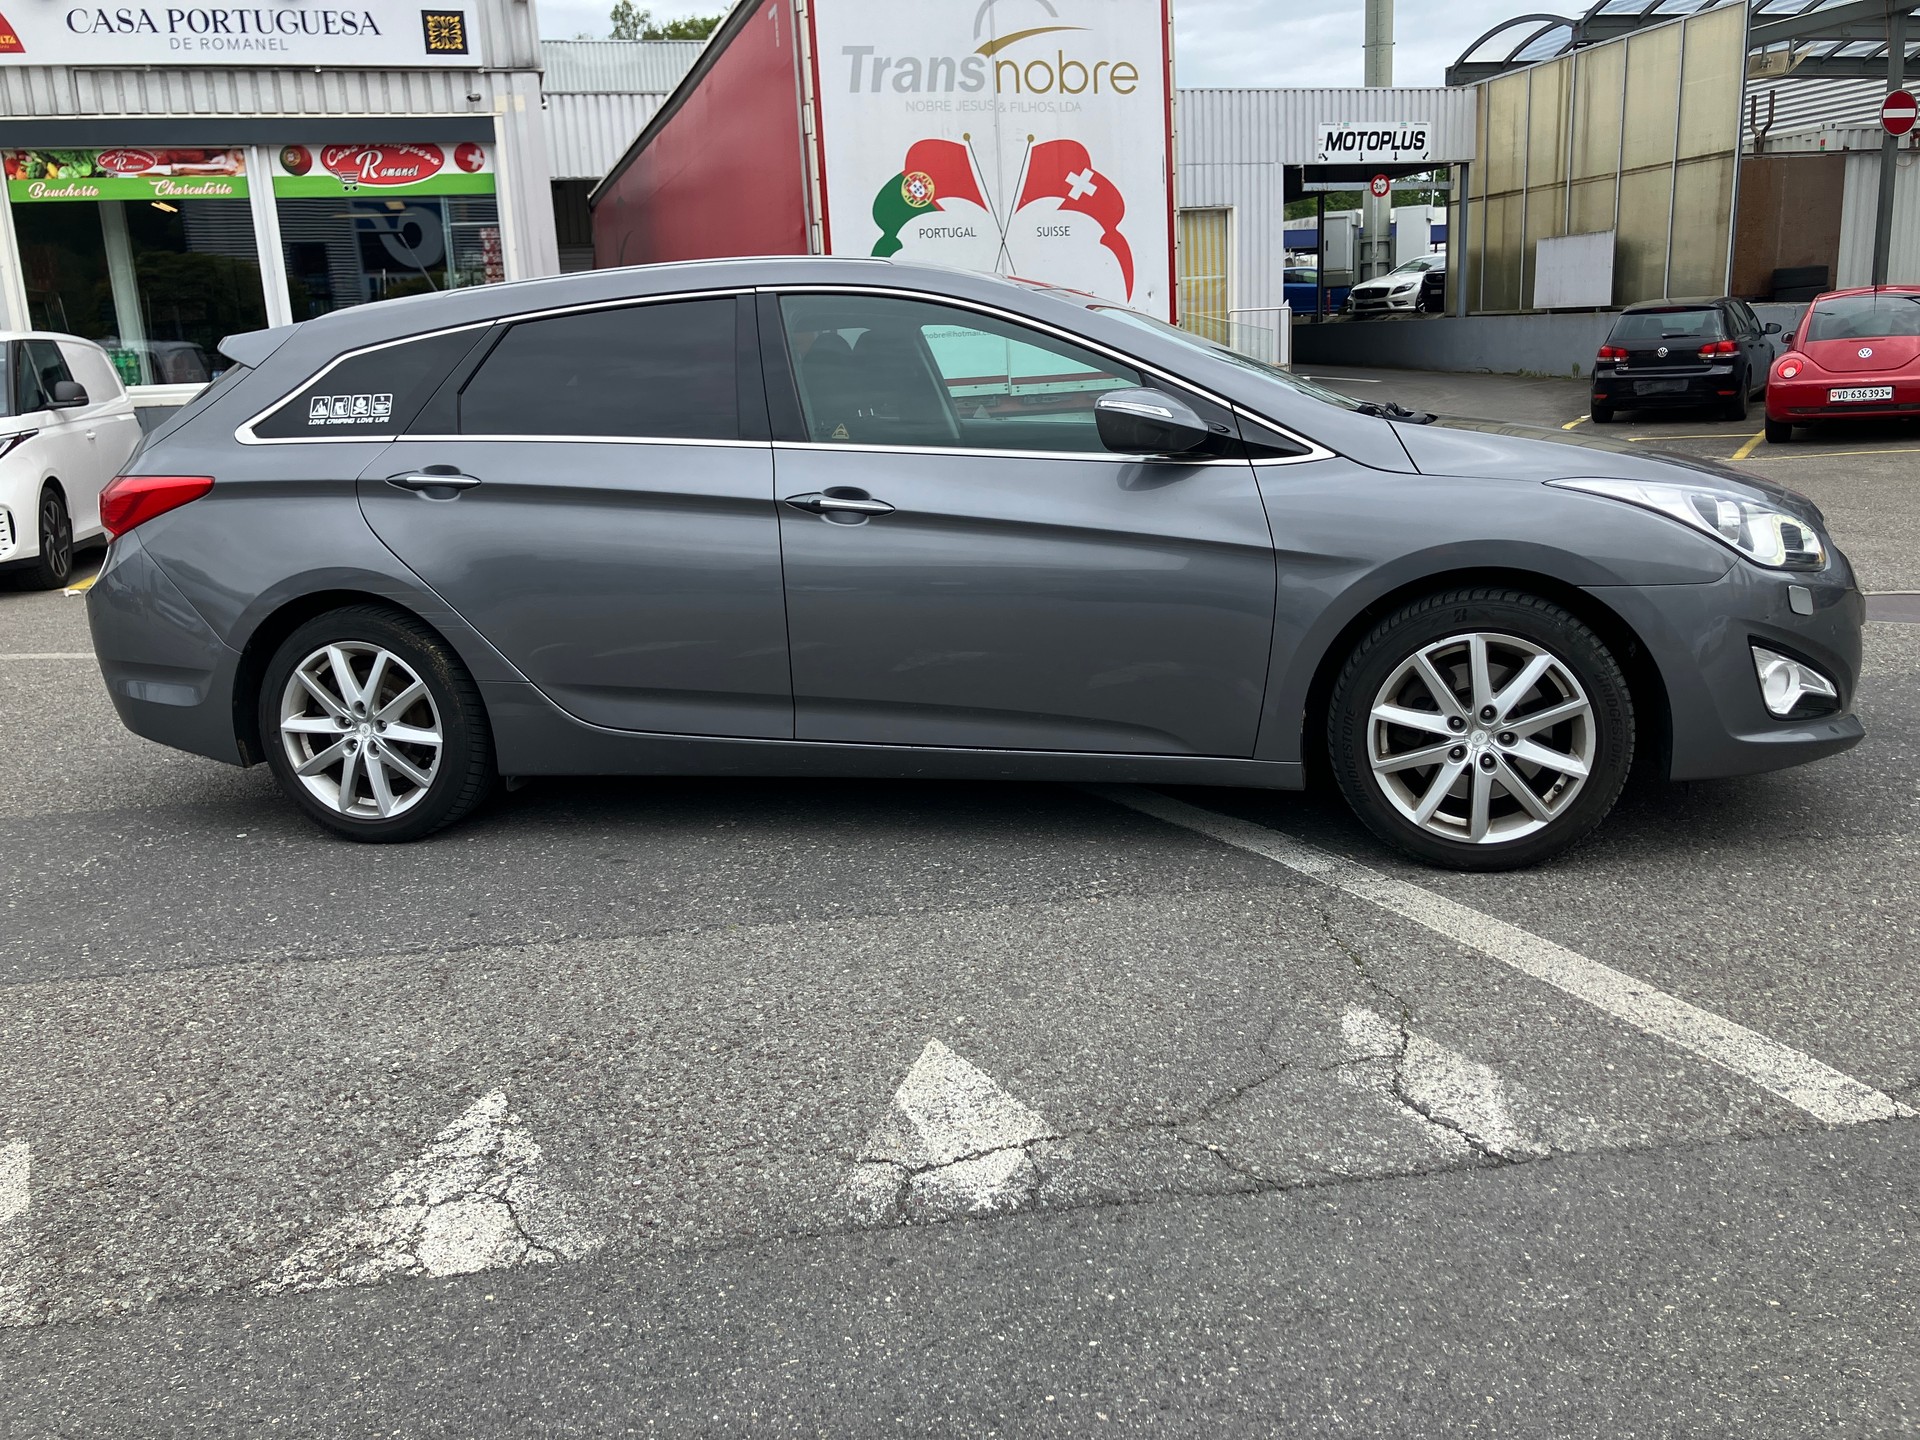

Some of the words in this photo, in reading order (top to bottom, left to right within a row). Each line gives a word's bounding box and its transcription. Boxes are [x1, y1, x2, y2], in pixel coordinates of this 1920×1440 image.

[66, 8, 160, 34] CASA
[166, 8, 382, 36] PORTUGUESA
[170, 37, 192, 50] DE
[201, 37, 289, 51] ROMANEL
[906, 100, 951, 113] NOBRE
[956, 100, 994, 113] JESUS
[998, 102, 1007, 113] &
[1059, 101, 1082, 113] LDA
[1325, 131, 1426, 151] MOTOPLUS
[355, 149, 419, 179] Romanel
[28, 182, 99, 199] Boucherie
[149, 179, 233, 196] Charcuterie
[919, 227, 977, 239] PORTUGAL
[1036, 226, 1070, 237] SUISSE
[356, 416, 374, 424] LOVE
